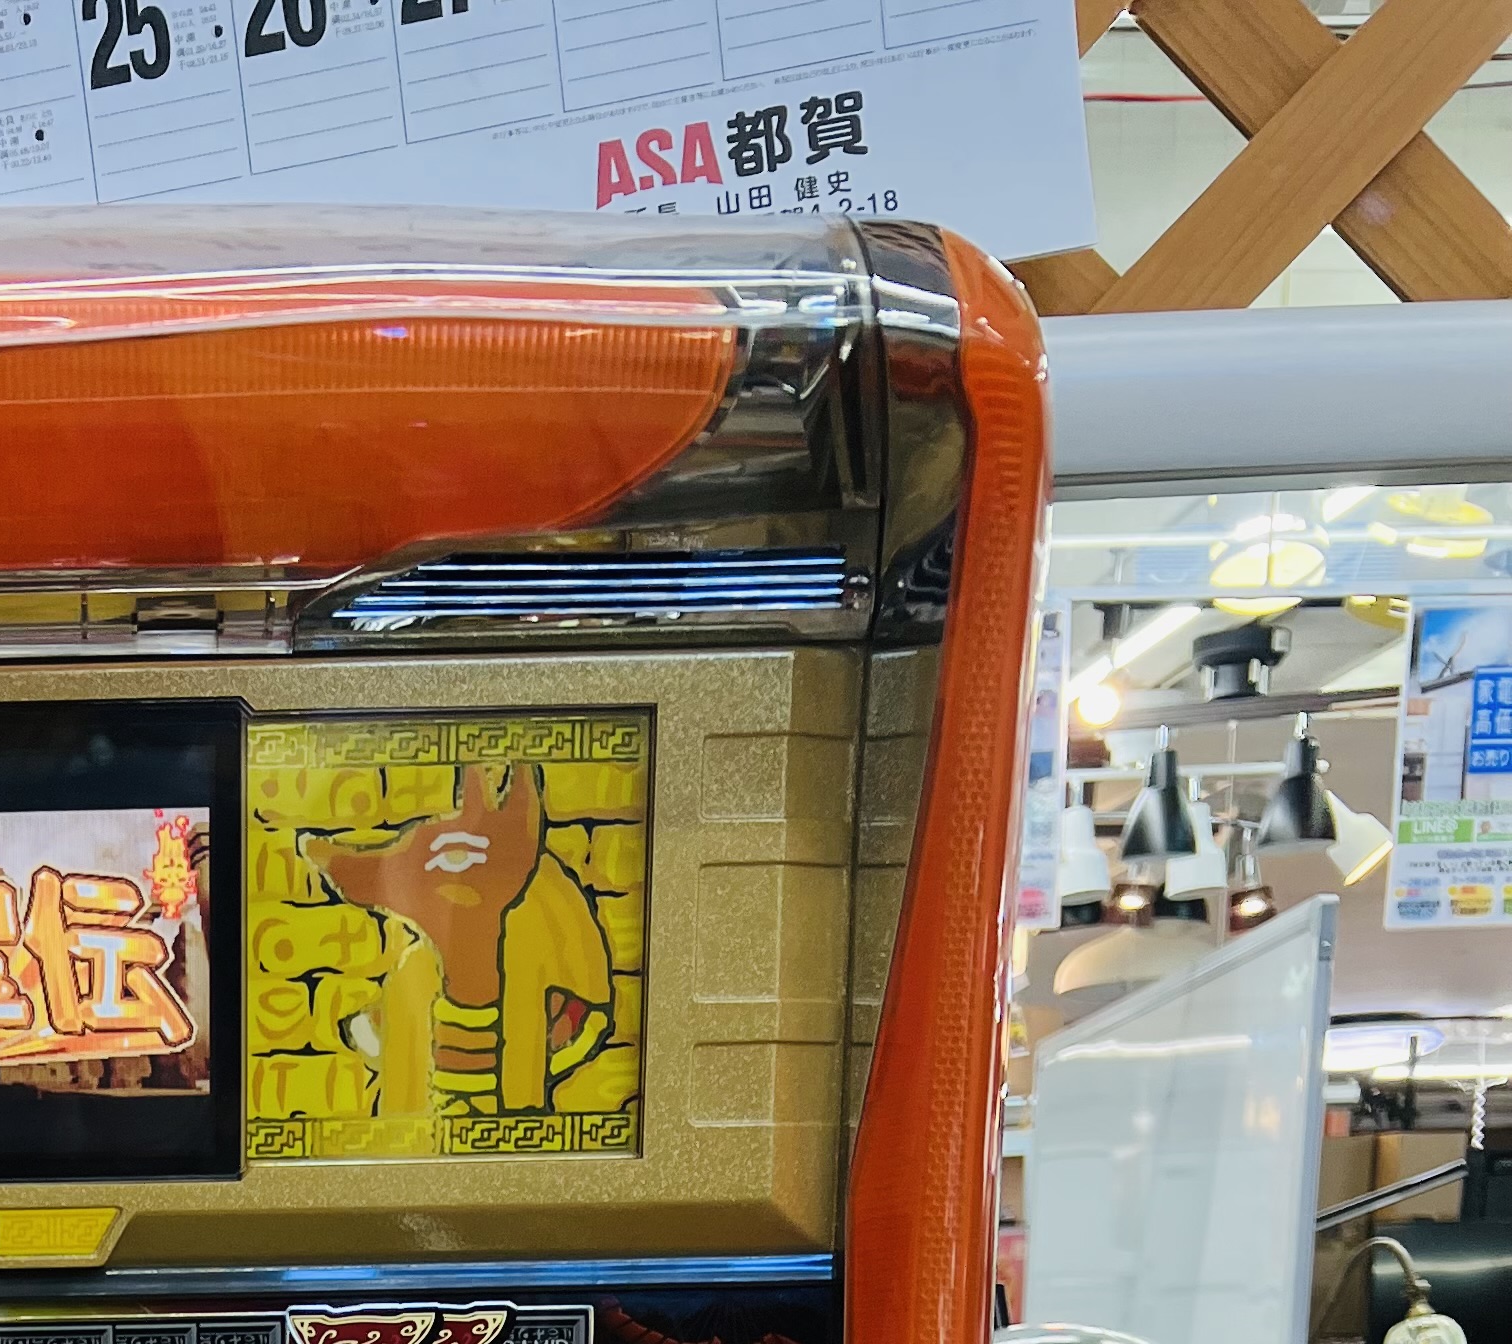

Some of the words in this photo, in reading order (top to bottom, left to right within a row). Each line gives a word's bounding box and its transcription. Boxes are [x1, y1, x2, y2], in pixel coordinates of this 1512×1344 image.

[82, 0, 171, 90] 25
[715, 186, 774, 215] 山田
[794, 171, 852, 202] 健史
